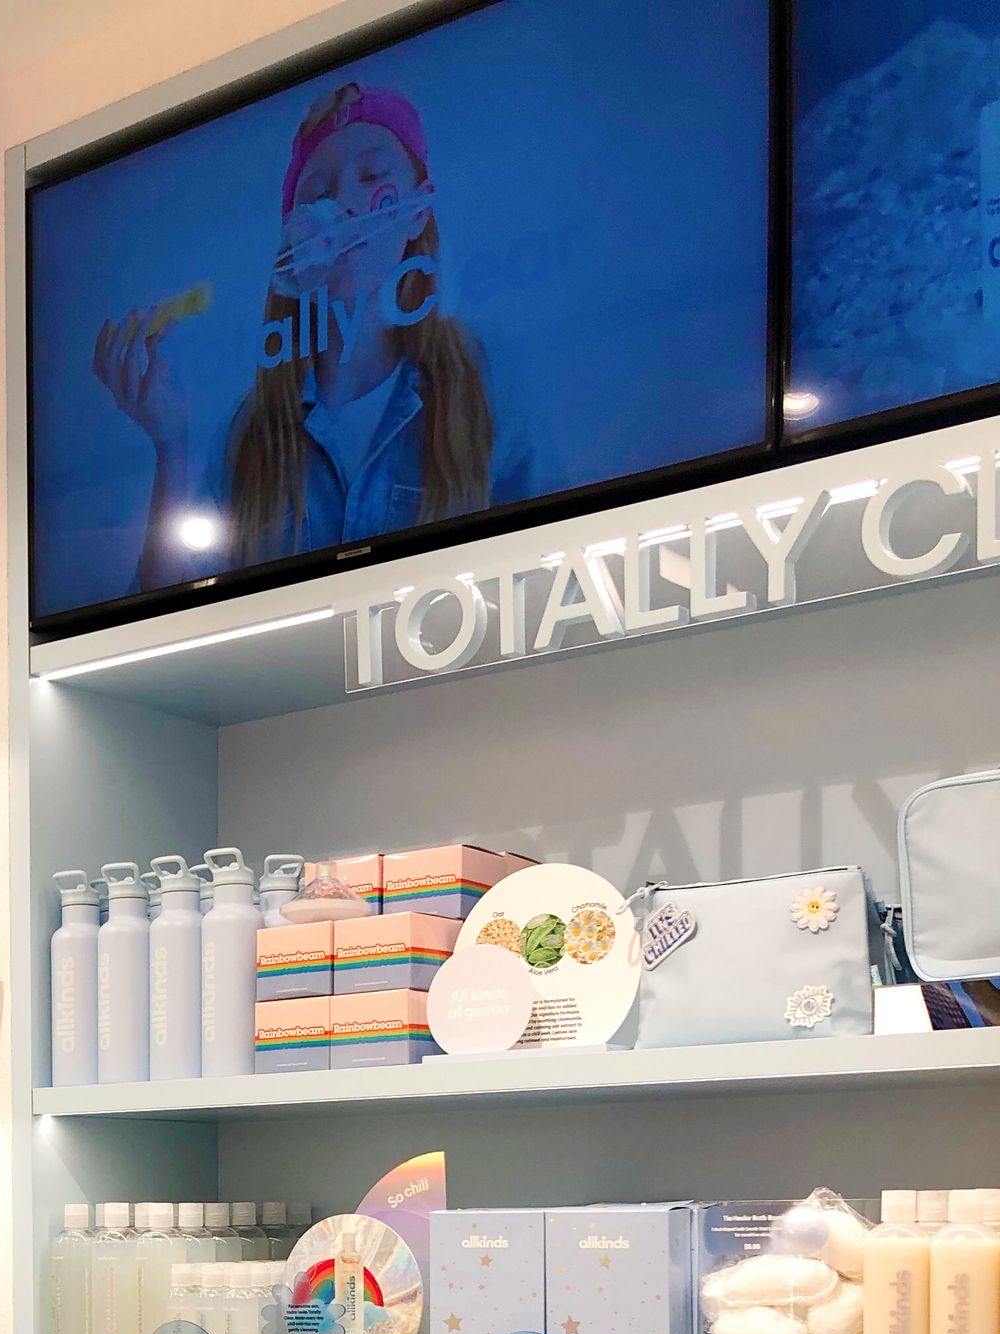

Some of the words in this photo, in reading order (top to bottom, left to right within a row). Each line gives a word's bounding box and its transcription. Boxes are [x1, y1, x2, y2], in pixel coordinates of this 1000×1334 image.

[343, 490, 831, 686] TOTALLY
[386, 873, 456, 891] Rainbowbeam
[571, 902, 608, 913] Chamomile
[259, 950, 325, 966] Rainbowbeam
[337, 942, 405, 958] Rainbowbeam
[528, 968, 543, 976] Aloe
[150, 945, 168, 1046] allkinds
[202, 940, 216, 1043] allkinds
[450, 988, 469, 1002] All
[470, 985, 509, 1001] kinds
[55, 955, 74, 1054] allkinds
[447, 1006, 462, 1020] of
[464, 1003, 511, 1021] gentle
[258, 1025, 325, 1040] Rainbowbeam
[333, 1019, 403, 1035] Rainbowbeam
[386, 1190, 404, 1209] So
[404, 1178, 430, 1199] chill
[461, 1235, 509, 1249] allkinds
[578, 1235, 630, 1249] allkinds
[346, 1274, 357, 1322] allkinds
